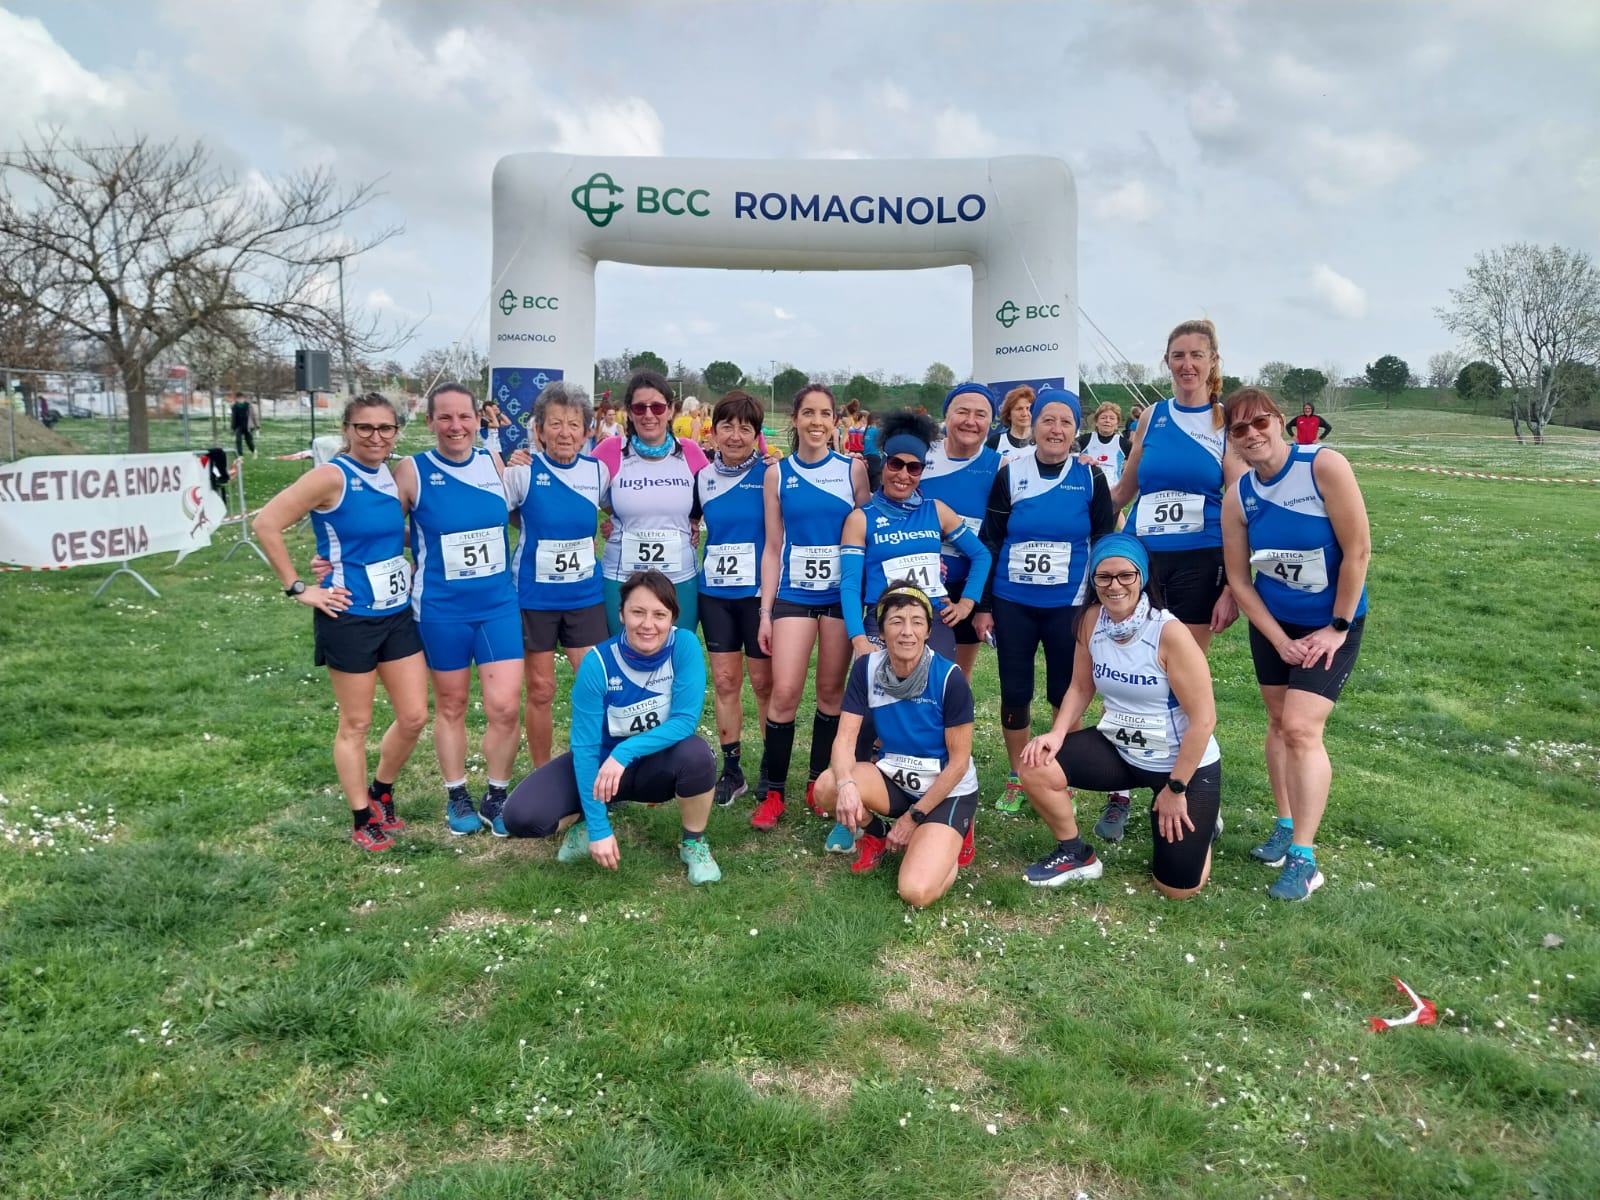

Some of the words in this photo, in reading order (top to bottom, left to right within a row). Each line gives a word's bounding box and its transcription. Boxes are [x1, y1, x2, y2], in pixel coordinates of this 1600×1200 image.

[637, 186, 710, 217] BCC
[735, 191, 986, 225] ROMAGNOLO
[523, 295, 559, 310] BCC
[1026, 304, 1060, 319] BCC
[497, 333, 557, 343] ROMAGNOLO
[995, 343, 1059, 355] ROMAGNOLO
[0, 469, 120, 502] TLETICA
[125, 466, 181, 496] ENDAS
[1154, 503, 1184, 523] 50
[52, 525, 148, 562] CESENA
[638, 543, 665, 562] 52
[463, 543, 490, 567] 51
[554, 552, 581, 573] 54
[716, 556, 738, 575] 42
[1023, 553, 1051, 573] 56
[805, 559, 832, 580] 55
[906, 566, 930, 587] 41
[1274, 562, 1303, 582] 47
[389, 570, 406, 596] 53
[630, 711, 661, 733] 48
[1116, 727, 1147, 748] 44
[892, 769, 921, 790] 46
